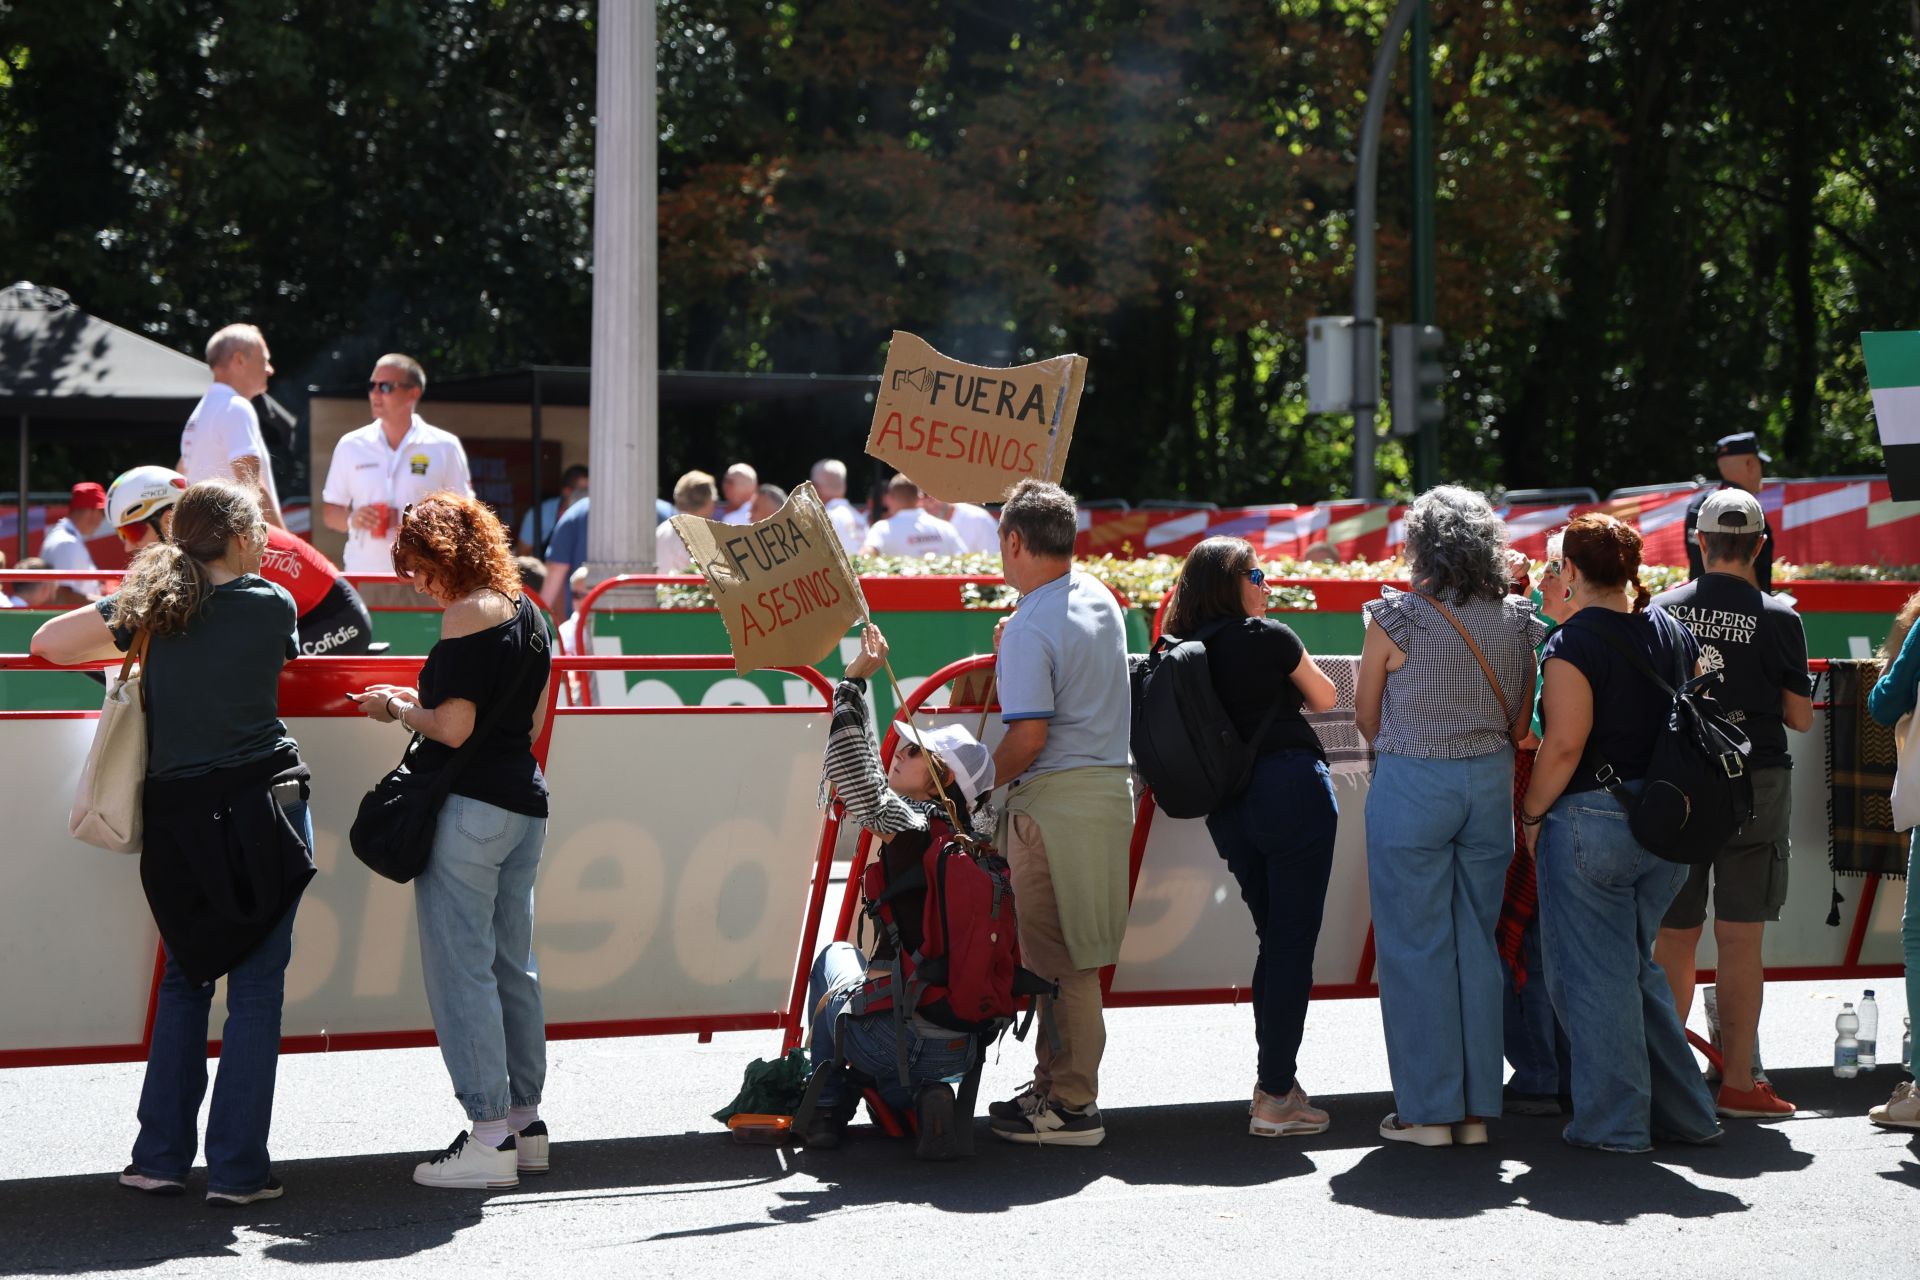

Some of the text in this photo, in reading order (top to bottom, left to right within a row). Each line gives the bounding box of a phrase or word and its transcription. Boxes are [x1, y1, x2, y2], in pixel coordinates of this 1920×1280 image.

[876, 412, 1038, 473] ASESINOS
[726, 517, 811, 582] FUERA
[740, 568, 841, 646] ASESINOS
[1667, 605, 1757, 630] SCALPERS
[302, 625, 359, 656] Cofidis
